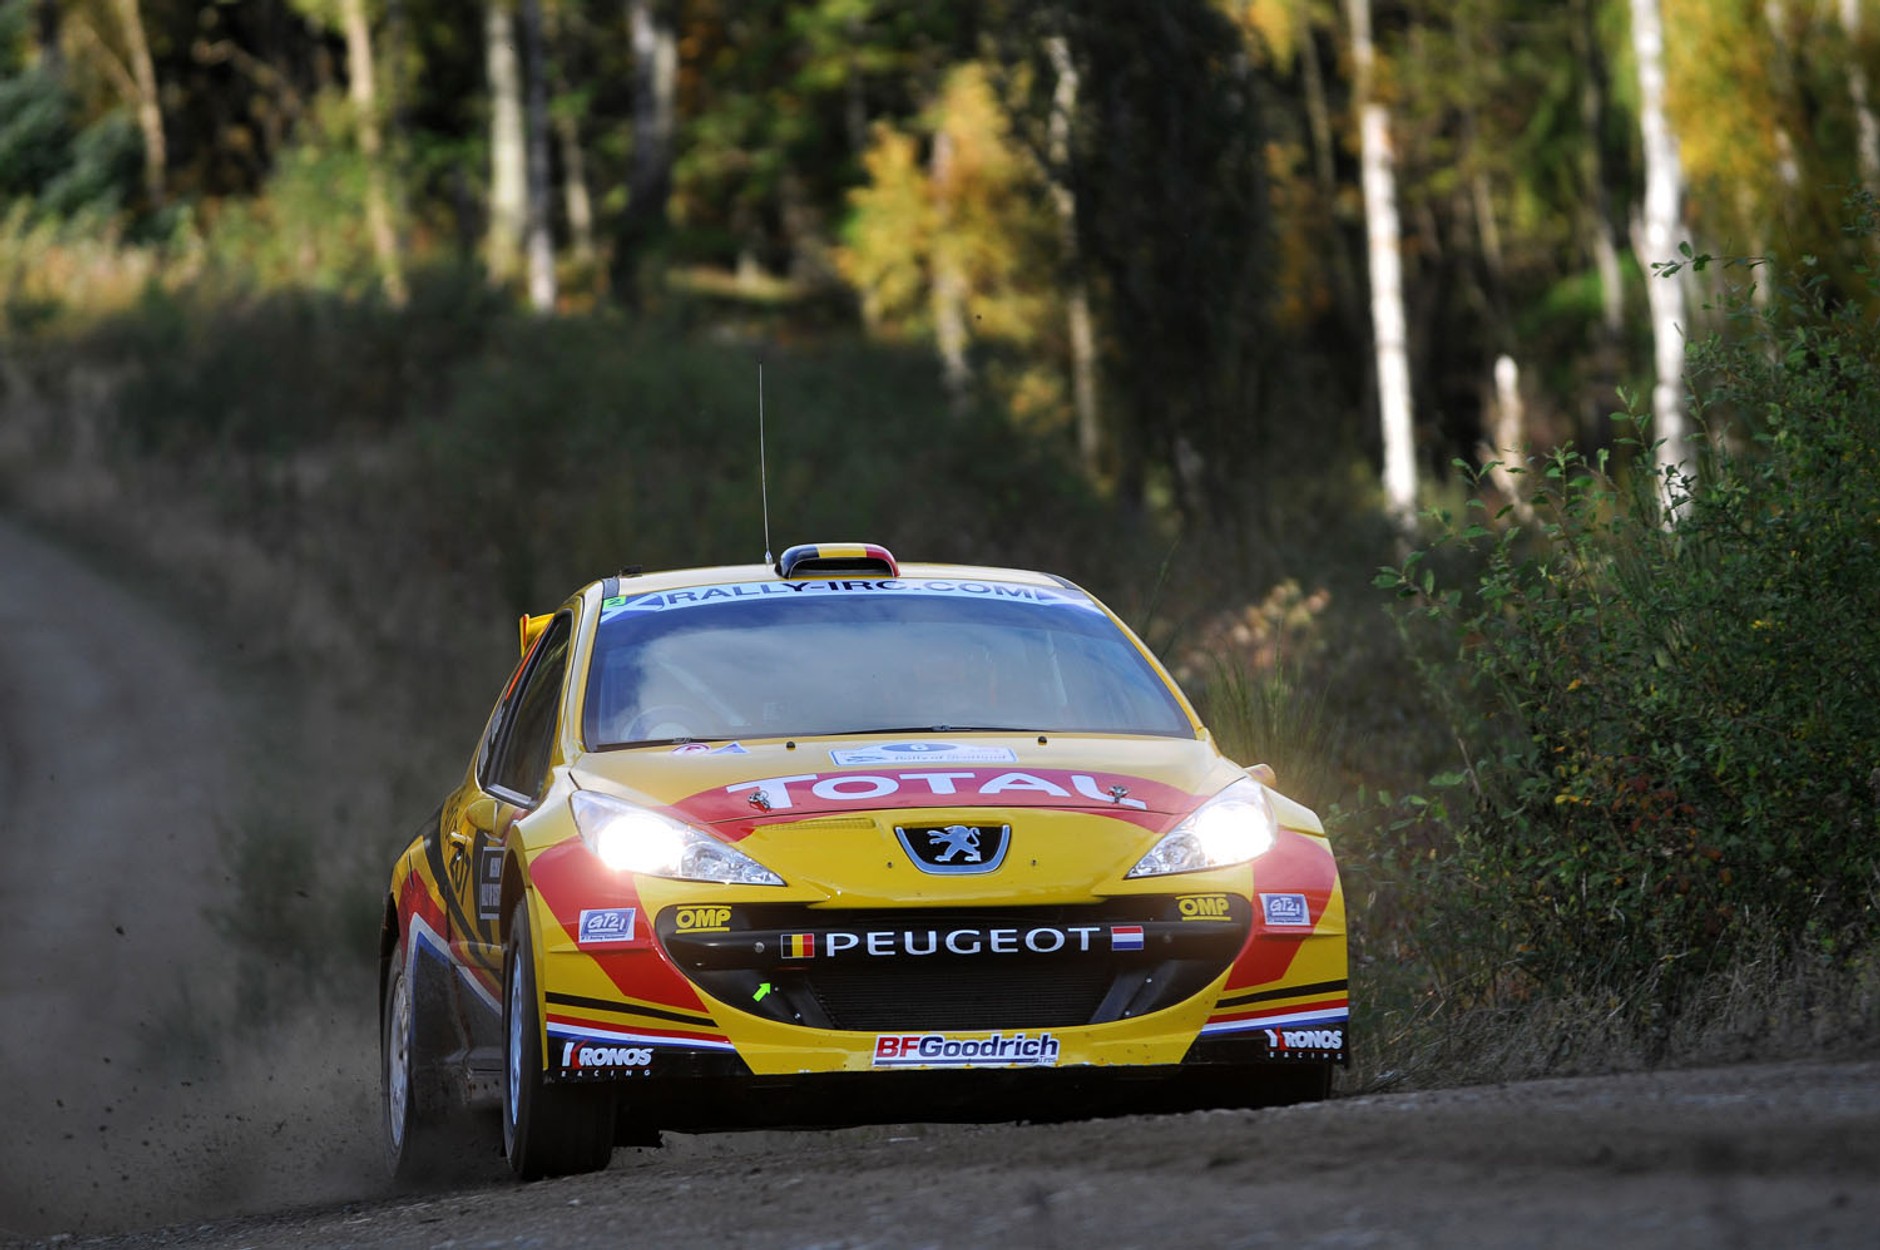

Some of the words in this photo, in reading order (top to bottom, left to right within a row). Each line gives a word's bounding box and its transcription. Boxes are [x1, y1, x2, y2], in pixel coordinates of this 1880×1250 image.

[665, 580, 1038, 605] RALLY-IRC.COM
[726, 771, 1149, 810] TOTAL
[676, 909, 732, 928] OMP
[1179, 898, 1231, 917] OMP
[826, 927, 1101, 956] PEUGEOT
[562, 1041, 654, 1069] KRONOS
[876, 1034, 1059, 1058] BFGoodrich
[561, 1069, 652, 1077] RACING
